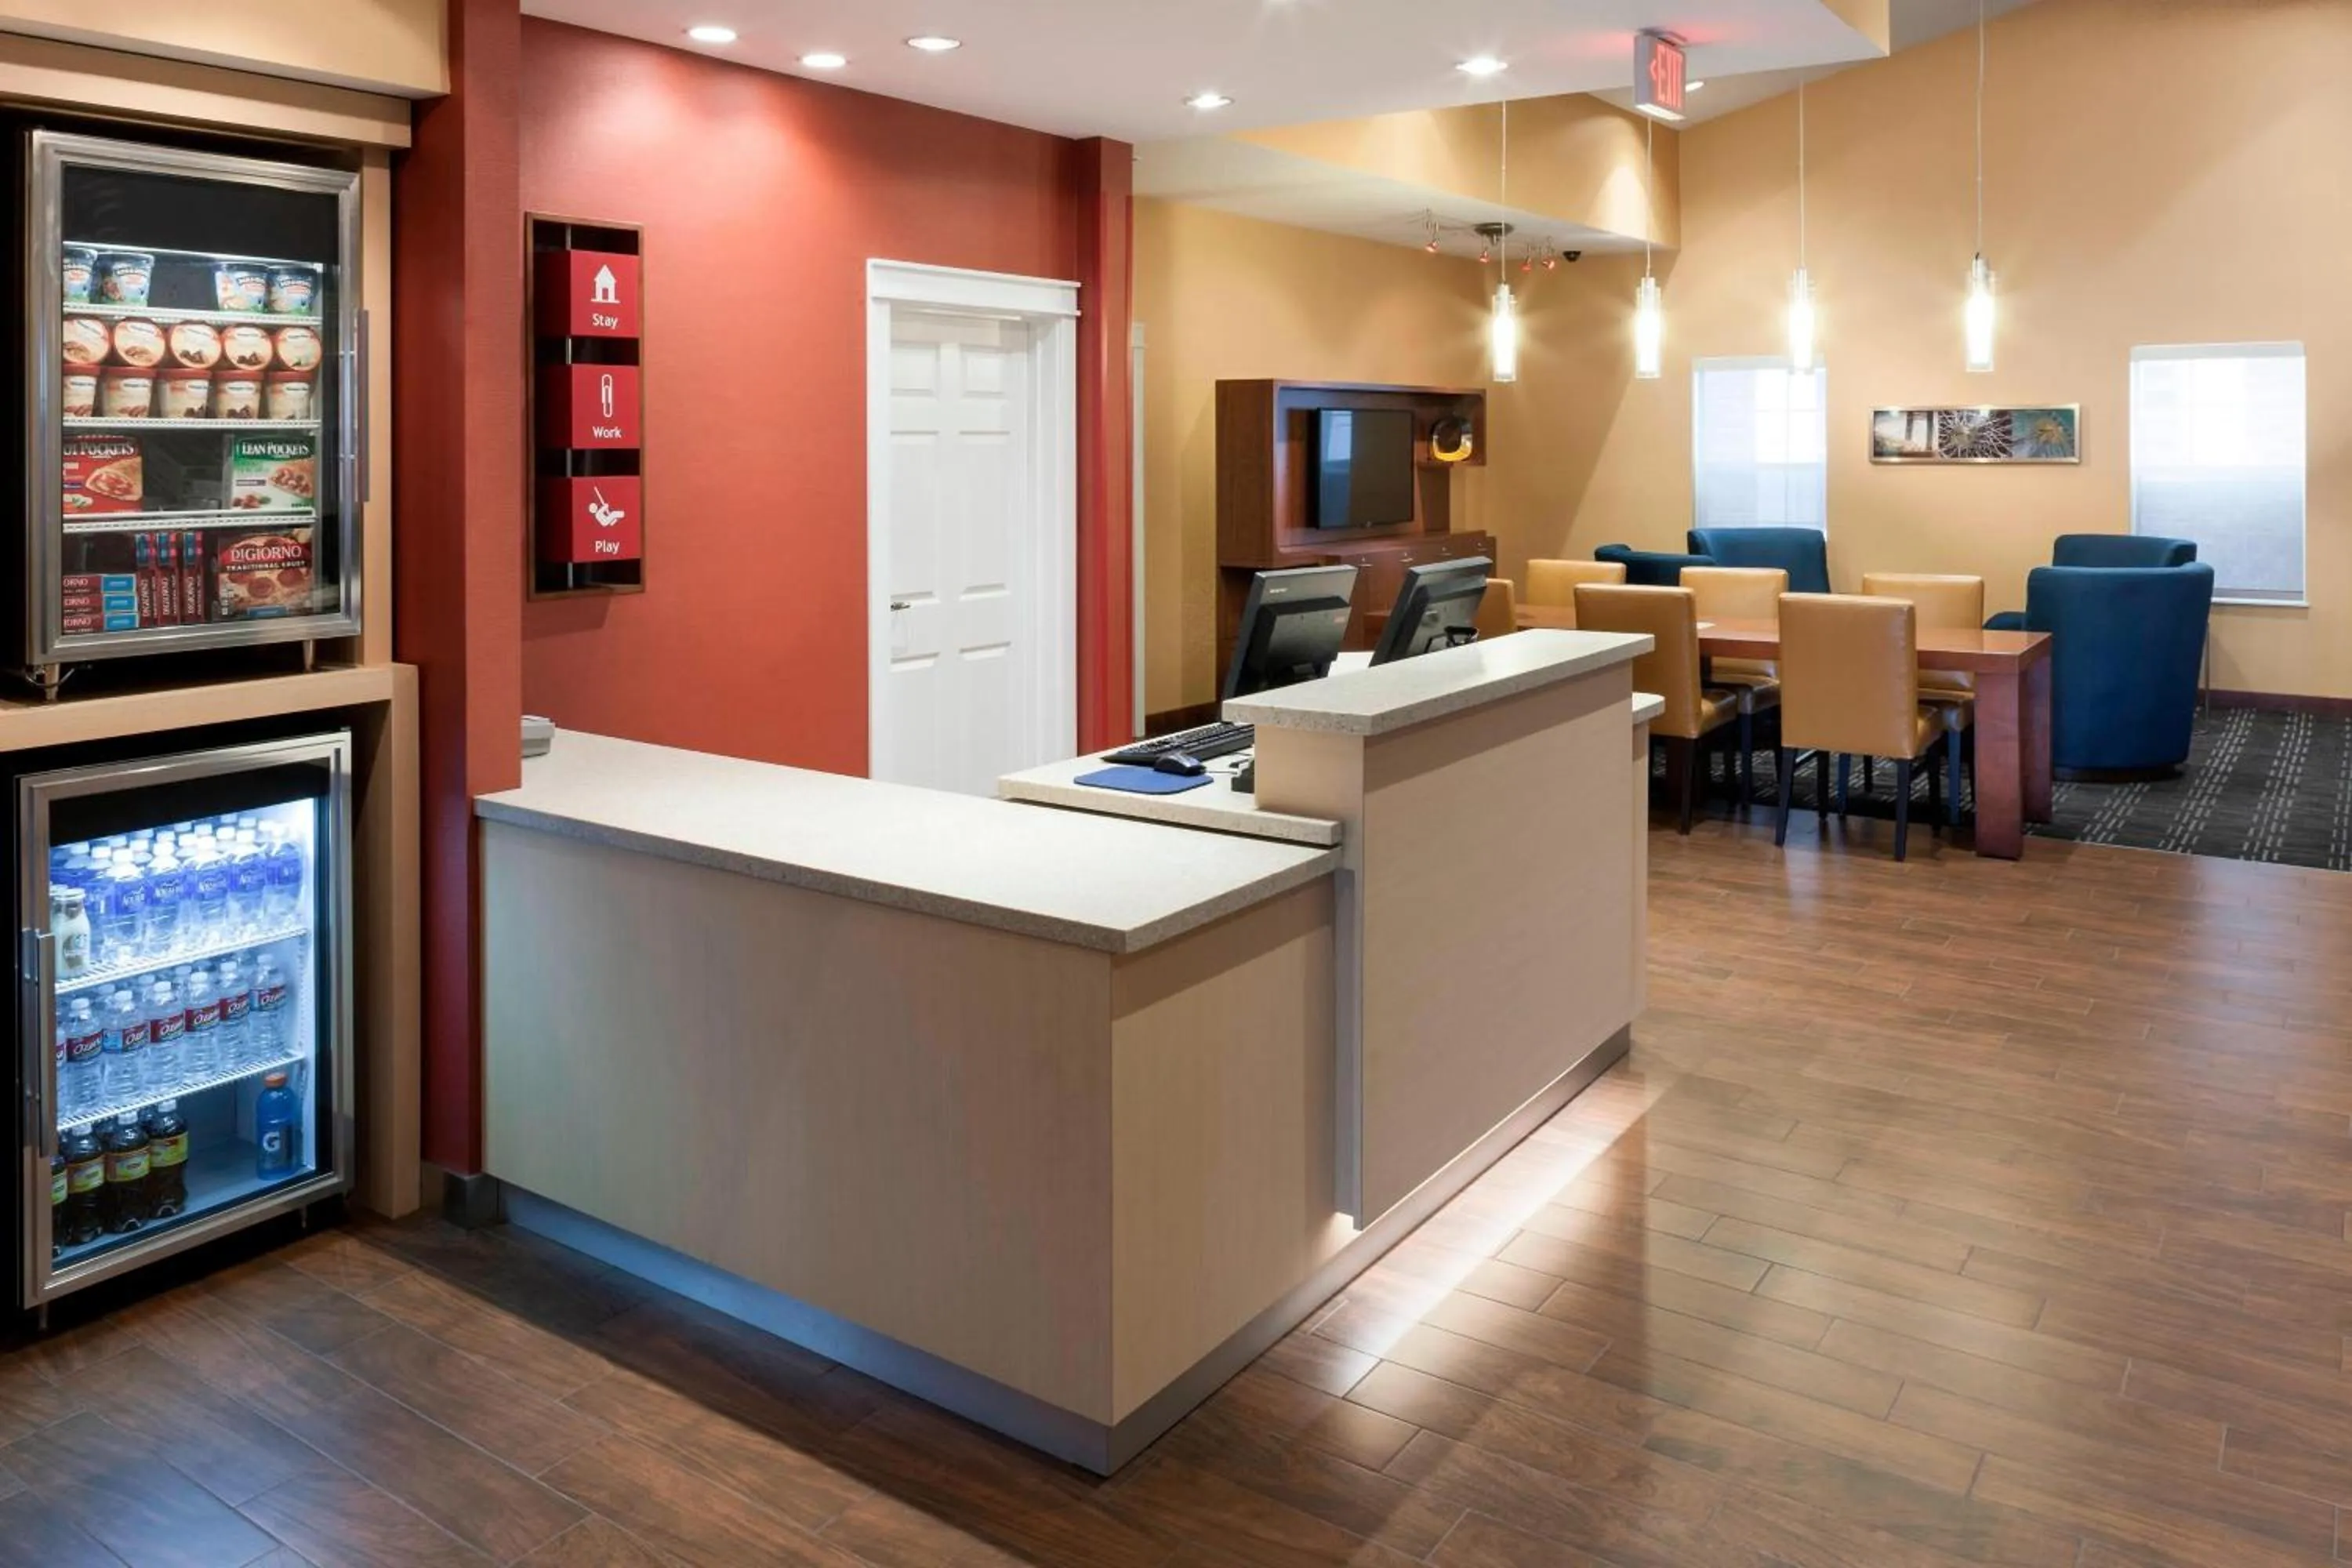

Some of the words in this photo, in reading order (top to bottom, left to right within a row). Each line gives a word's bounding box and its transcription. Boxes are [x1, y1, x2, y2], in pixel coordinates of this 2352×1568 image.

[592, 313, 619, 330] Stay
[592, 426, 622, 439] Work
[64, 443, 78, 456] OT
[80, 441, 134, 456] POCKETS
[241, 441, 266, 456] LEAN
[267, 441, 310, 456] POCKETS
[595, 539, 620, 555] Play
[263, 1131, 280, 1152] G
